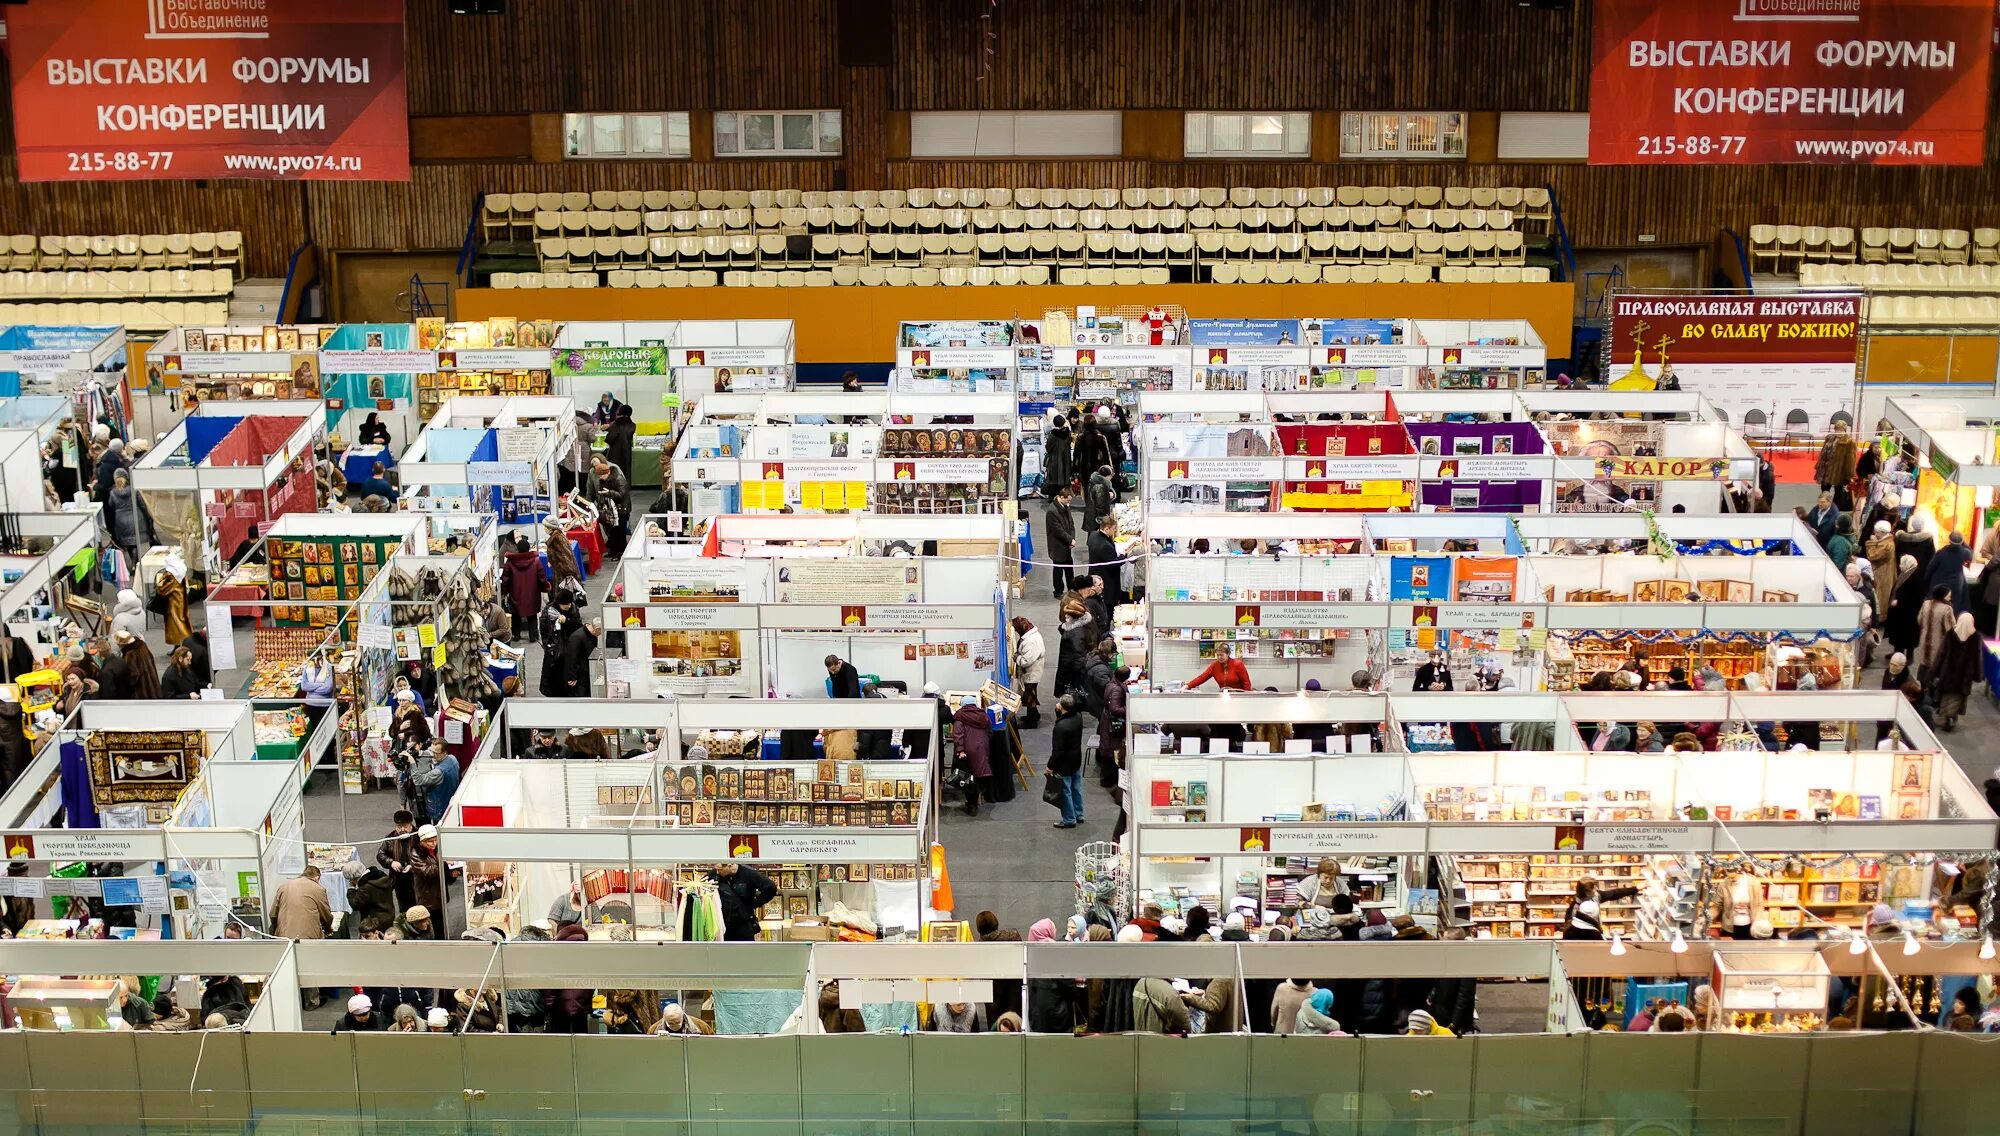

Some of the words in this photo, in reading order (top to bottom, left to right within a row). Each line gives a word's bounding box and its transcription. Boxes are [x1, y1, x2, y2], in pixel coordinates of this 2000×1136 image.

[168, 13, 269, 30] Объединение
[1629, 40, 1791, 67] ВЫСТАВКИ
[1816, 40, 1956, 69] ФОРУМЫ
[47, 58, 207, 85] ВЫСТАВКИ
[232, 57, 370, 84] ФОРУМЫ
[1674, 87, 1905, 117] КОНФЕРЕНЦИИ
[97, 104, 326, 133] КОНФЕРЕНЦИИ
[1638, 135, 1747, 155] 215-88-77
[1795, 140, 1935, 159] www.pvo74.ru
[67, 151, 173, 172] 215-88-77
[224, 154, 362, 174] www.pvo74.ru
[1618, 301, 1754, 316] ПРАВОСЛАВНАЯ
[1760, 301, 1855, 316] ВЫСТАВКА
[1681, 323, 1705, 338] ВО
[1711, 323, 1773, 342] СЛАВУ
[1777, 322, 1855, 338] БОЖИЮ!
[13, 353, 71, 362] ПРАВОСЛАВНАЯ
[584, 350, 651, 362] КЕДРОВЫЕ
[1624, 460, 1703, 476] КАГОР
[77, 842, 131, 850] ПОБЕДОНОСЦА
